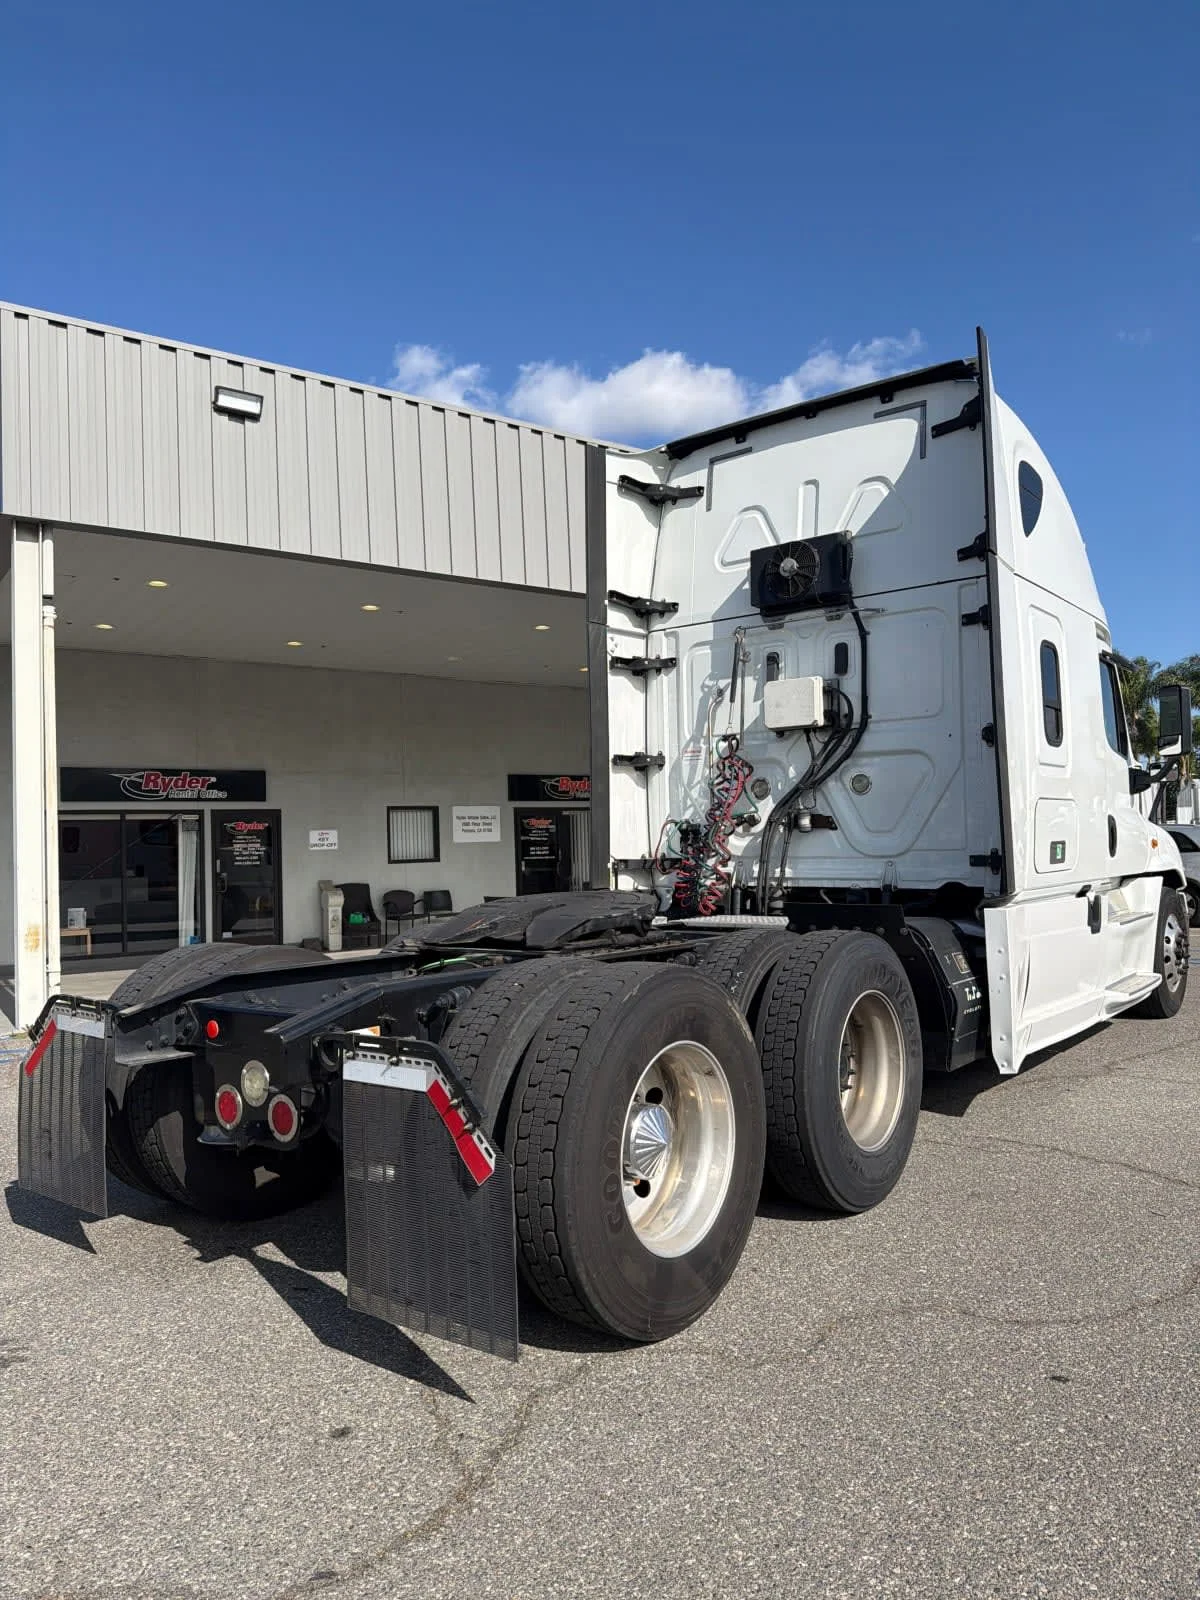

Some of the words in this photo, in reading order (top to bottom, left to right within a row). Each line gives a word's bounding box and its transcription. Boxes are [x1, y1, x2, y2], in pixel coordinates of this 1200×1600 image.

[142, 771, 212, 794] Ryder
[168, 789, 198, 799] Rental
[200, 789, 228, 799] Office
[235, 821, 265, 833] Ryder
